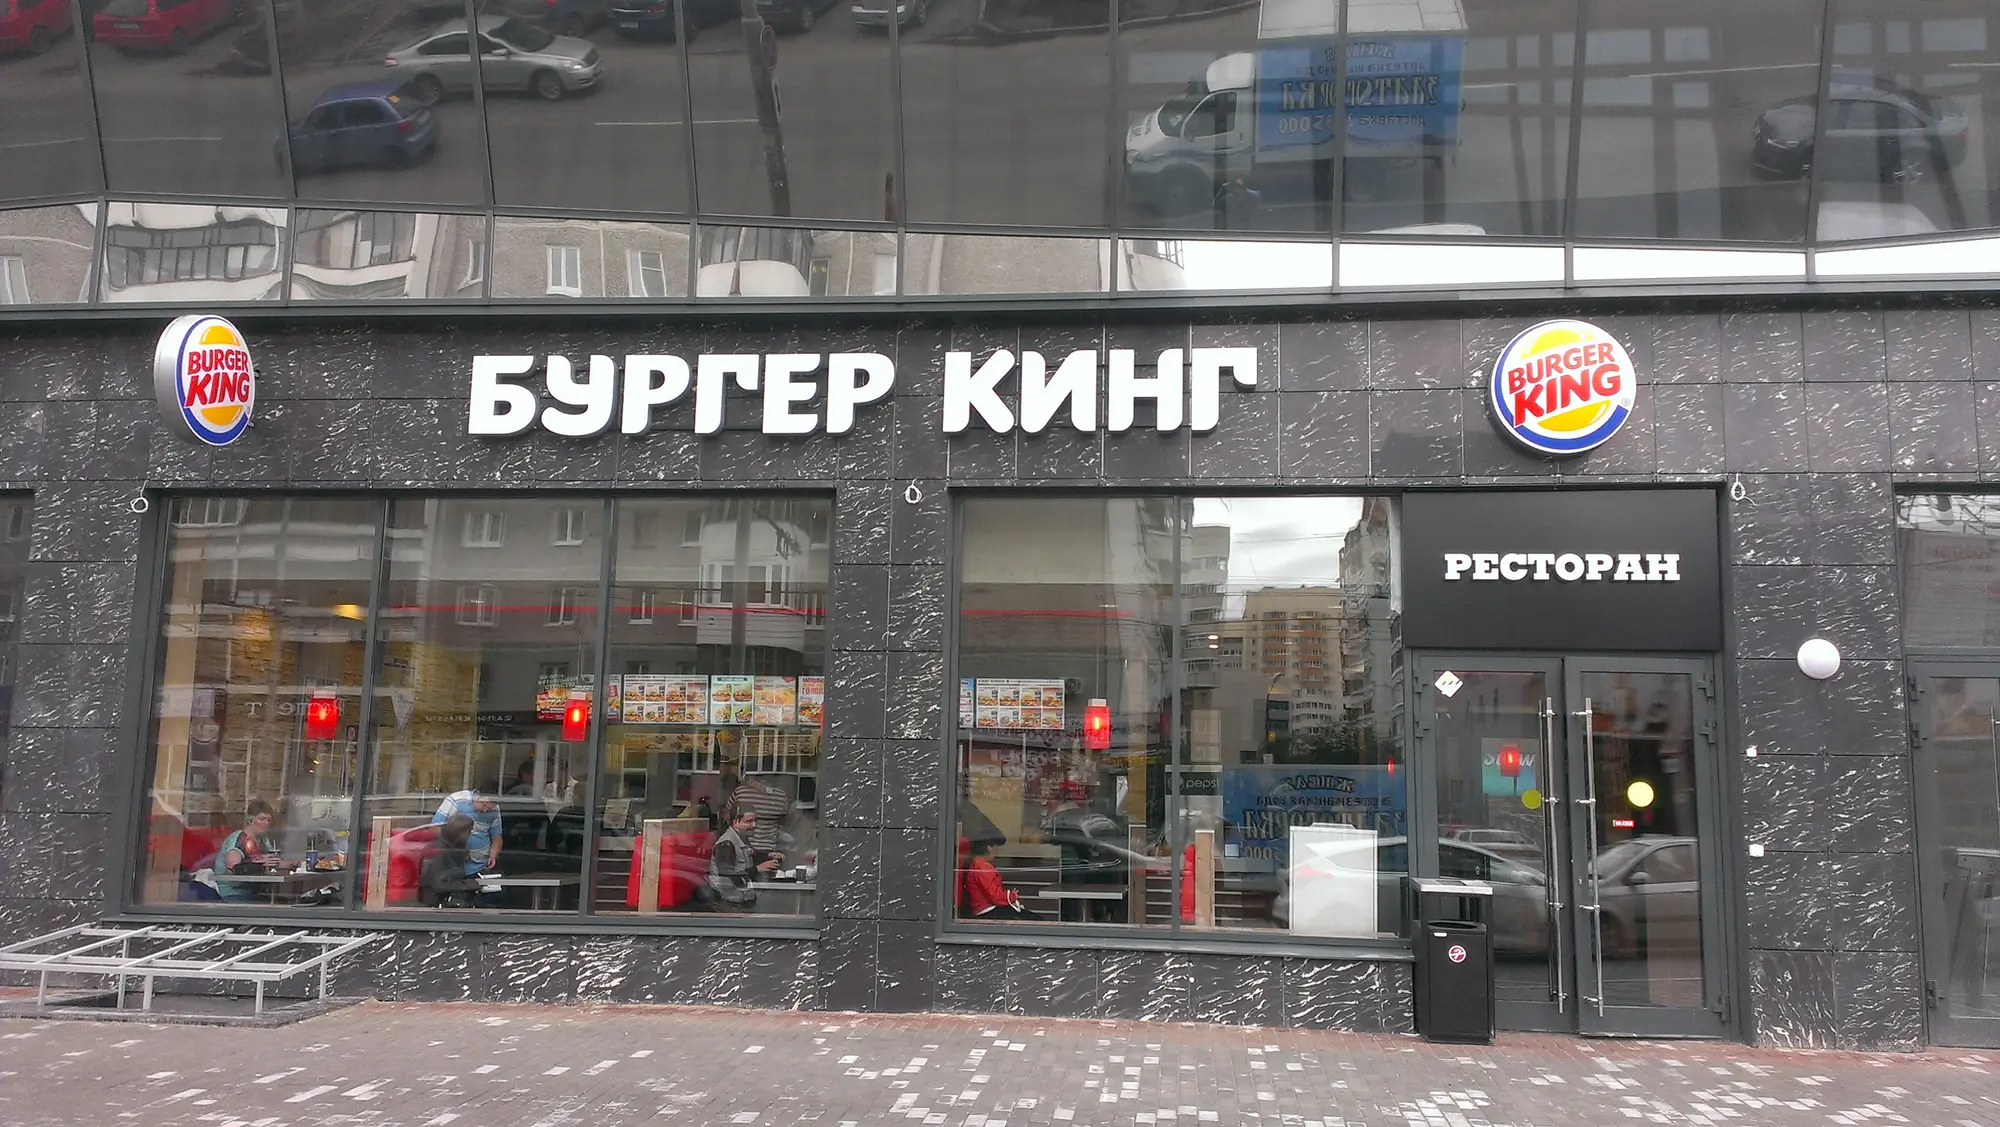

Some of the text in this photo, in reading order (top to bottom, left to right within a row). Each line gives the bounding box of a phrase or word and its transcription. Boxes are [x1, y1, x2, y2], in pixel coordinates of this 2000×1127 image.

[187, 348, 249, 375] BURGER
[1508, 342, 1615, 395] BURGER
[185, 372, 250, 407] KING
[467, 348, 1258, 436] БУРГЕР КИНГ
[1514, 363, 1621, 427] KING
[1444, 553, 1681, 581] РЕСТОРАН
